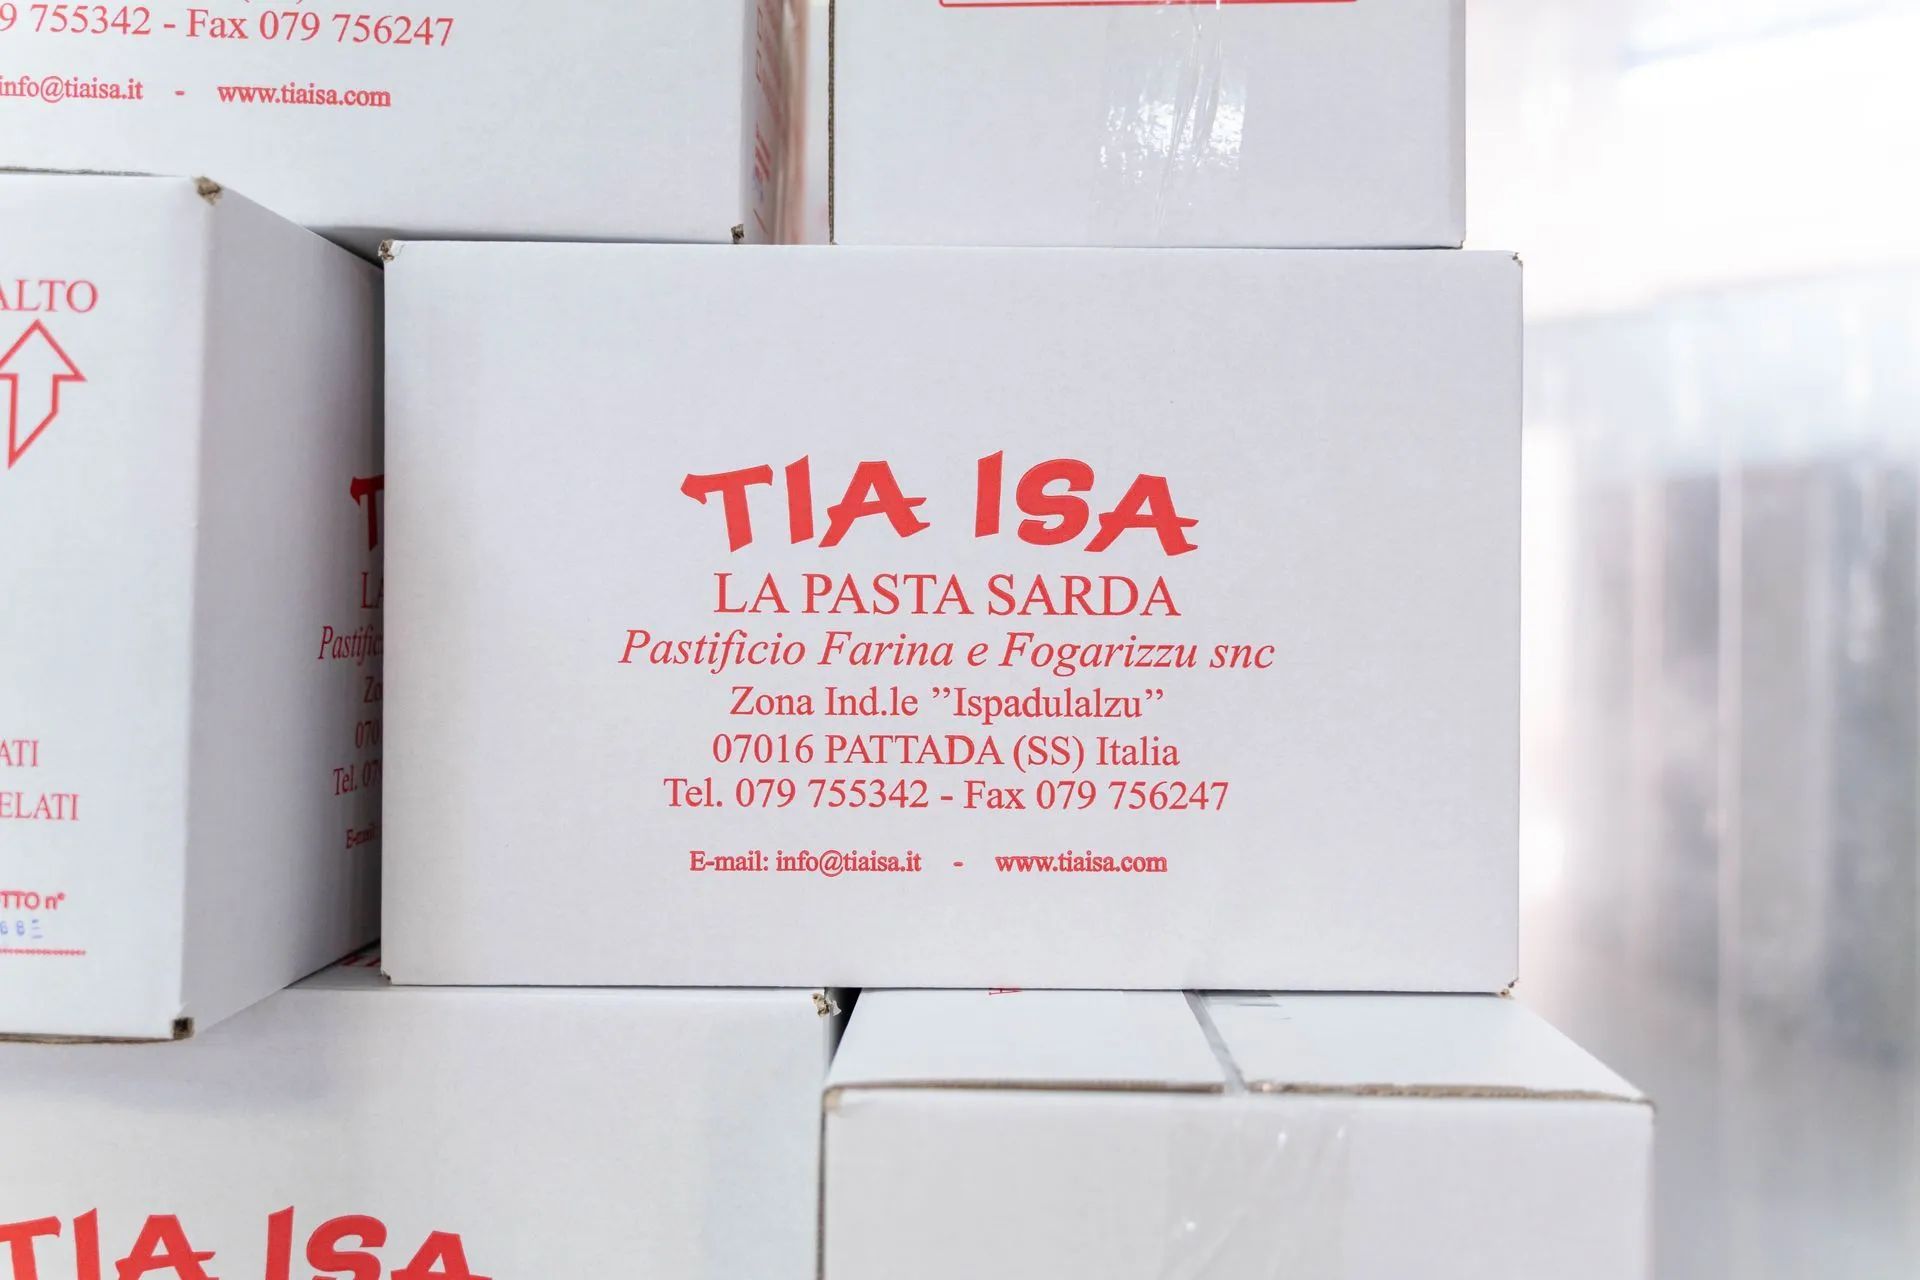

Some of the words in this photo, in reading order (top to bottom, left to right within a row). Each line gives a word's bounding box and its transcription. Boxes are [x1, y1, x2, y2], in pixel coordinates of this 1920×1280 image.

[30, 4, 152, 36] 755342
[163, 22, 176, 30] -
[186, 8, 248, 40] Fax
[259, 11, 321, 41] 079
[332, 13, 455, 47] 756247
[0, 75, 144, 104] info@tiaisa.it
[175, 89, 186, 97] -
[217, 82, 392, 107] www.tiaisa.com
[680, 455, 932, 553] TIA
[975, 450, 1199, 557] ISA
[715, 572, 790, 614] LA
[803, 572, 974, 616] PASTA
[987, 573, 1182, 618] SARDA
[619, 629, 807, 675] Pastificio
[817, 630, 954, 668] Farina
[966, 642, 989, 667] e
[999, 630, 1198, 677] Fogarizzu
[1208, 643, 1276, 670] snc
[729, 685, 815, 717] Zona
[825, 685, 919, 718] Ind.le
[712, 733, 815, 766] 07016
[826, 734, 1004, 767] PATTADA
[1012, 736, 1086, 773] (SS)
[1096, 736, 1180, 768] Italia
[663, 777, 725, 808] Tel.
[735, 778, 797, 808] 079
[807, 778, 929, 809] 755342
[939, 793, 954, 802] -
[964, 778, 1026, 810] Fax
[1035, 778, 1098, 810] 079
[1108, 779, 1230, 811] 756247
[689, 849, 769, 873] E-mail:
[776, 848, 923, 879] info@tiaisa.it
[953, 860, 965, 869] -
[994, 850, 1169, 874] www.tiaisa.com
[264, 1206, 494, 1280] ISA
